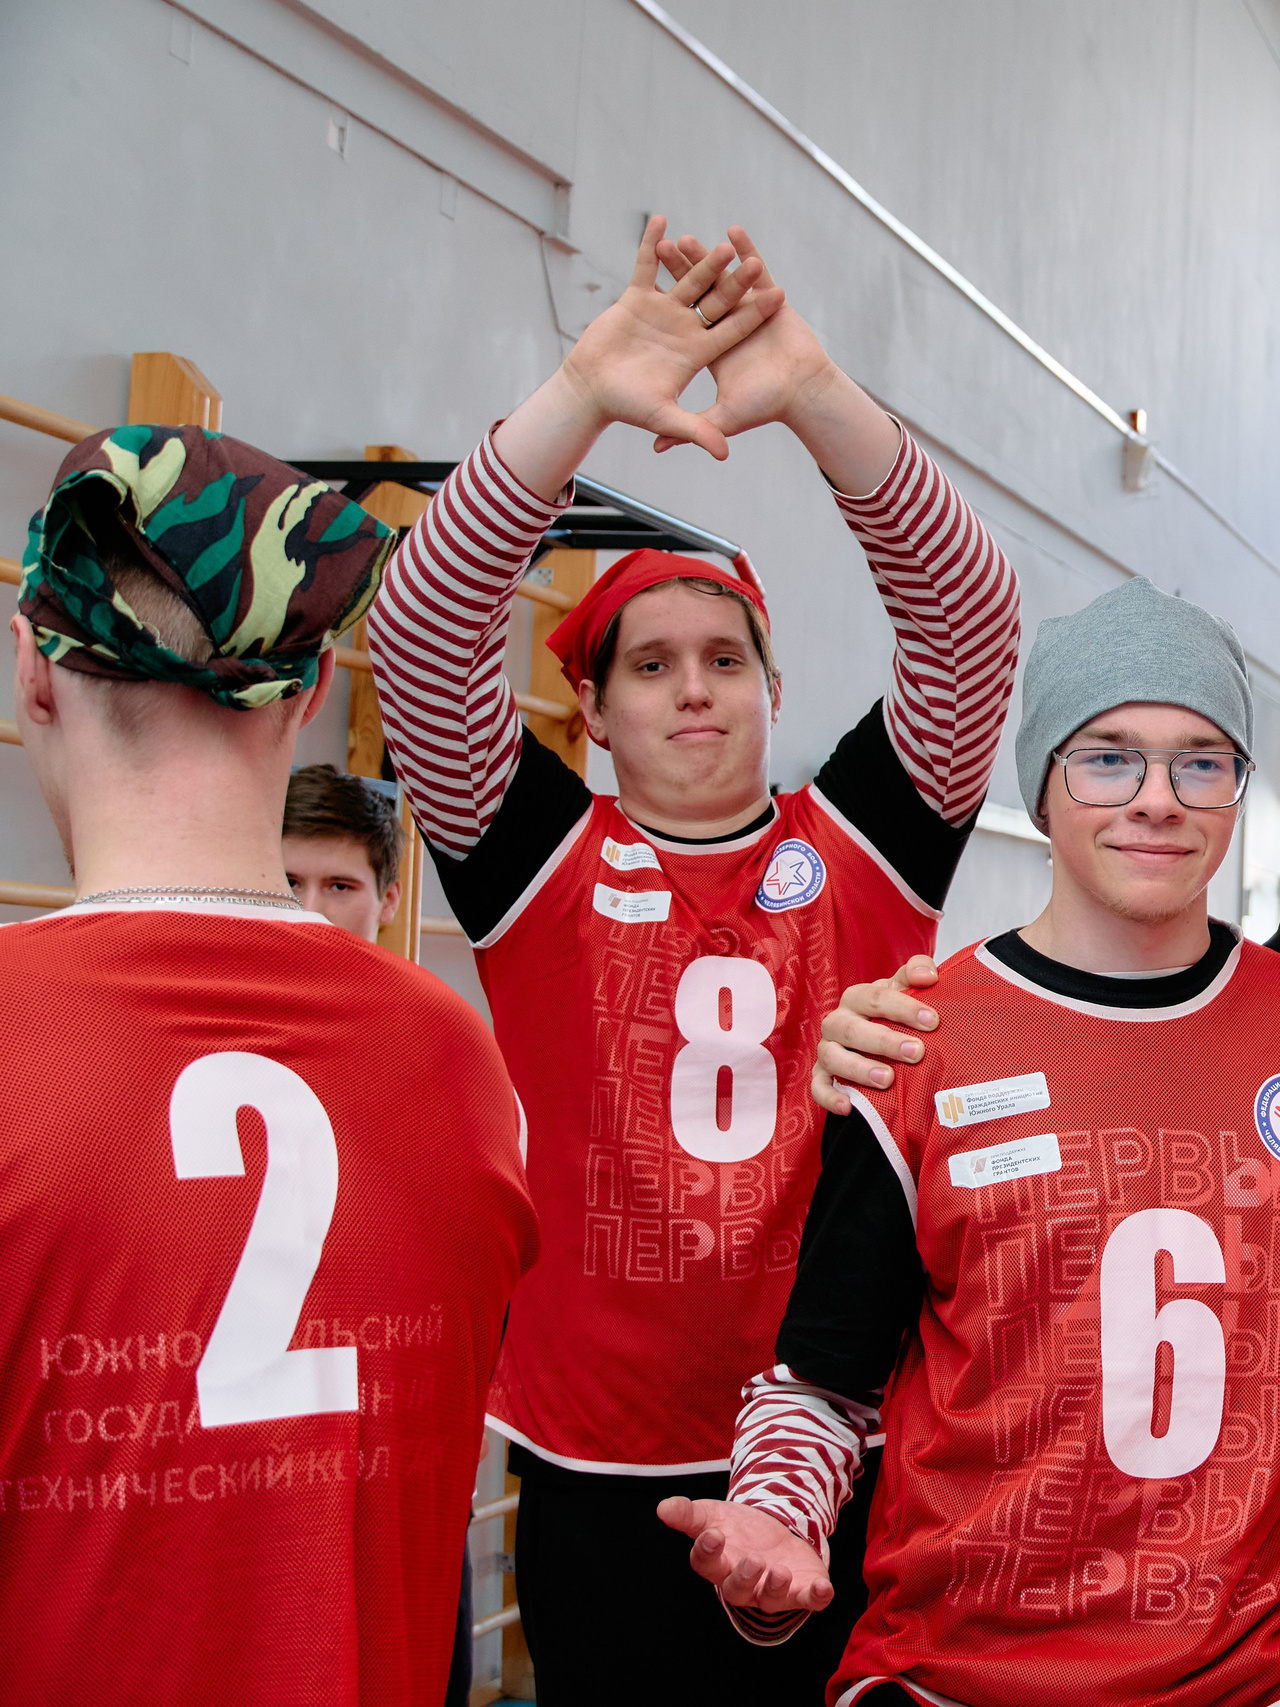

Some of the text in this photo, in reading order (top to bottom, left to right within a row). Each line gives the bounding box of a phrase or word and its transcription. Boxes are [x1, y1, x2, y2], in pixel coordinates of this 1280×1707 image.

[670, 955, 777, 1163] 8
[966, 1095, 987, 1103] Фонда
[967, 1097, 1008, 1110] гражданских
[969, 1102, 1016, 1116] Южного Урала
[991, 1156, 1012, 1165] ФОНДА
[992, 1156, 1041, 1171] ПРЕЗИДЕНТСКИХ
[993, 1167, 1019, 1176] ГРАНТОВ
[169, 1050, 359, 1428] 2
[1100, 1208, 1226, 1479] 6
